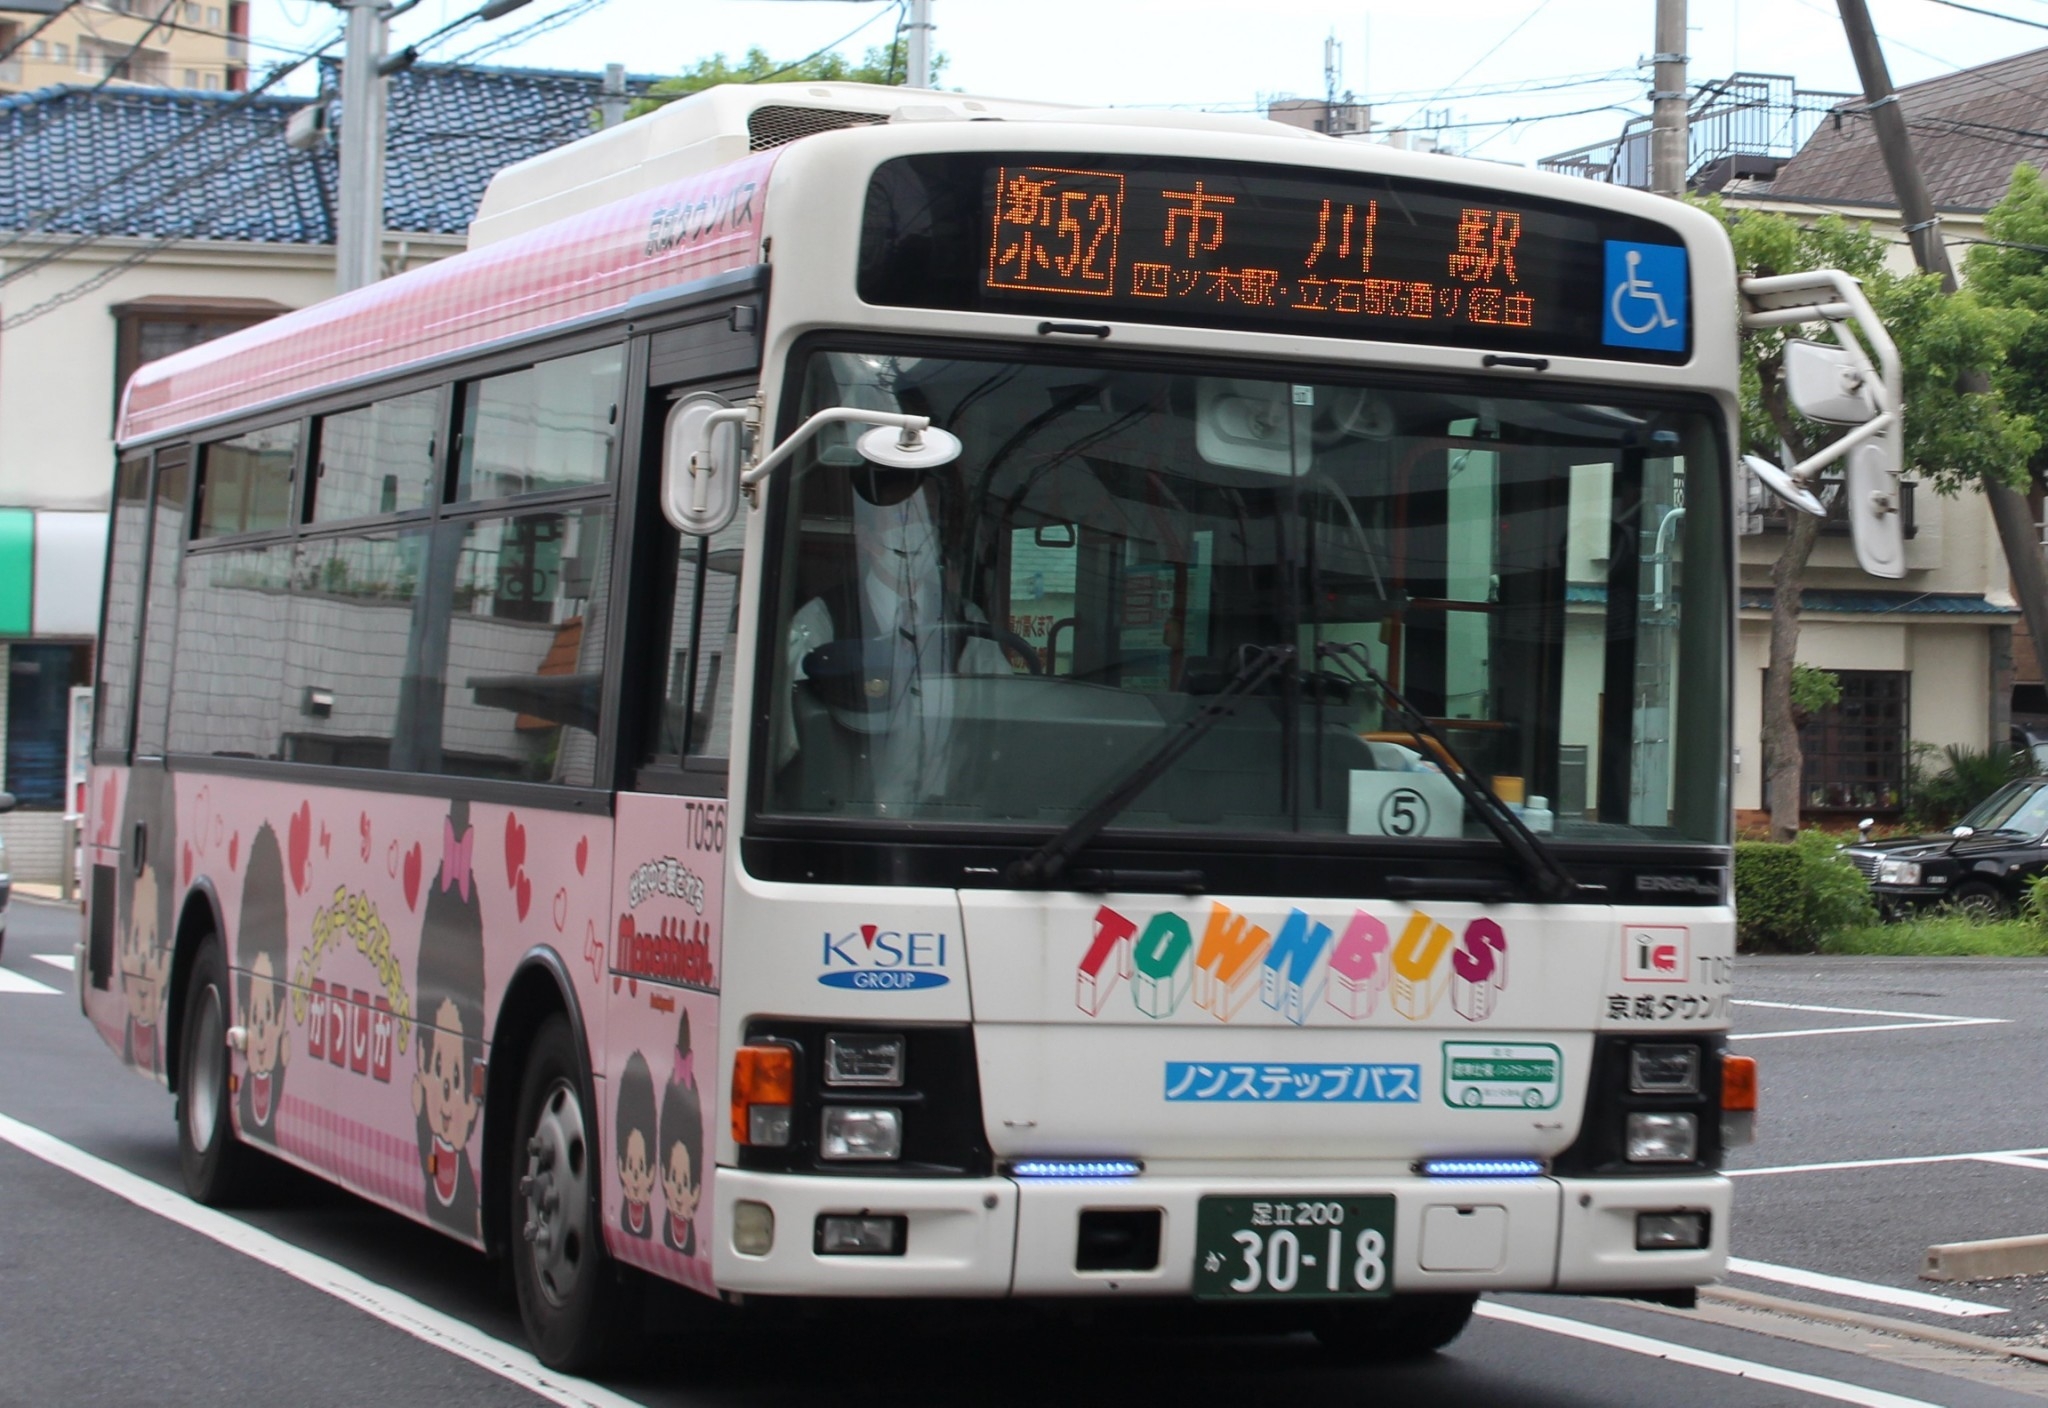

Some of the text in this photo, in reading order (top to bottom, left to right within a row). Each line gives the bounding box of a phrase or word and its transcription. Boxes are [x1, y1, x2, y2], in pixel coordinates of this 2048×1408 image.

[684, 803, 726, 853] T056
[853, 972, 916, 989] GROUP
[308, 985, 393, 1072] かつしか
[1166, 1065, 1419, 1101] ノンステップバス
[1230, 1228, 1386, 1293] 30-18
